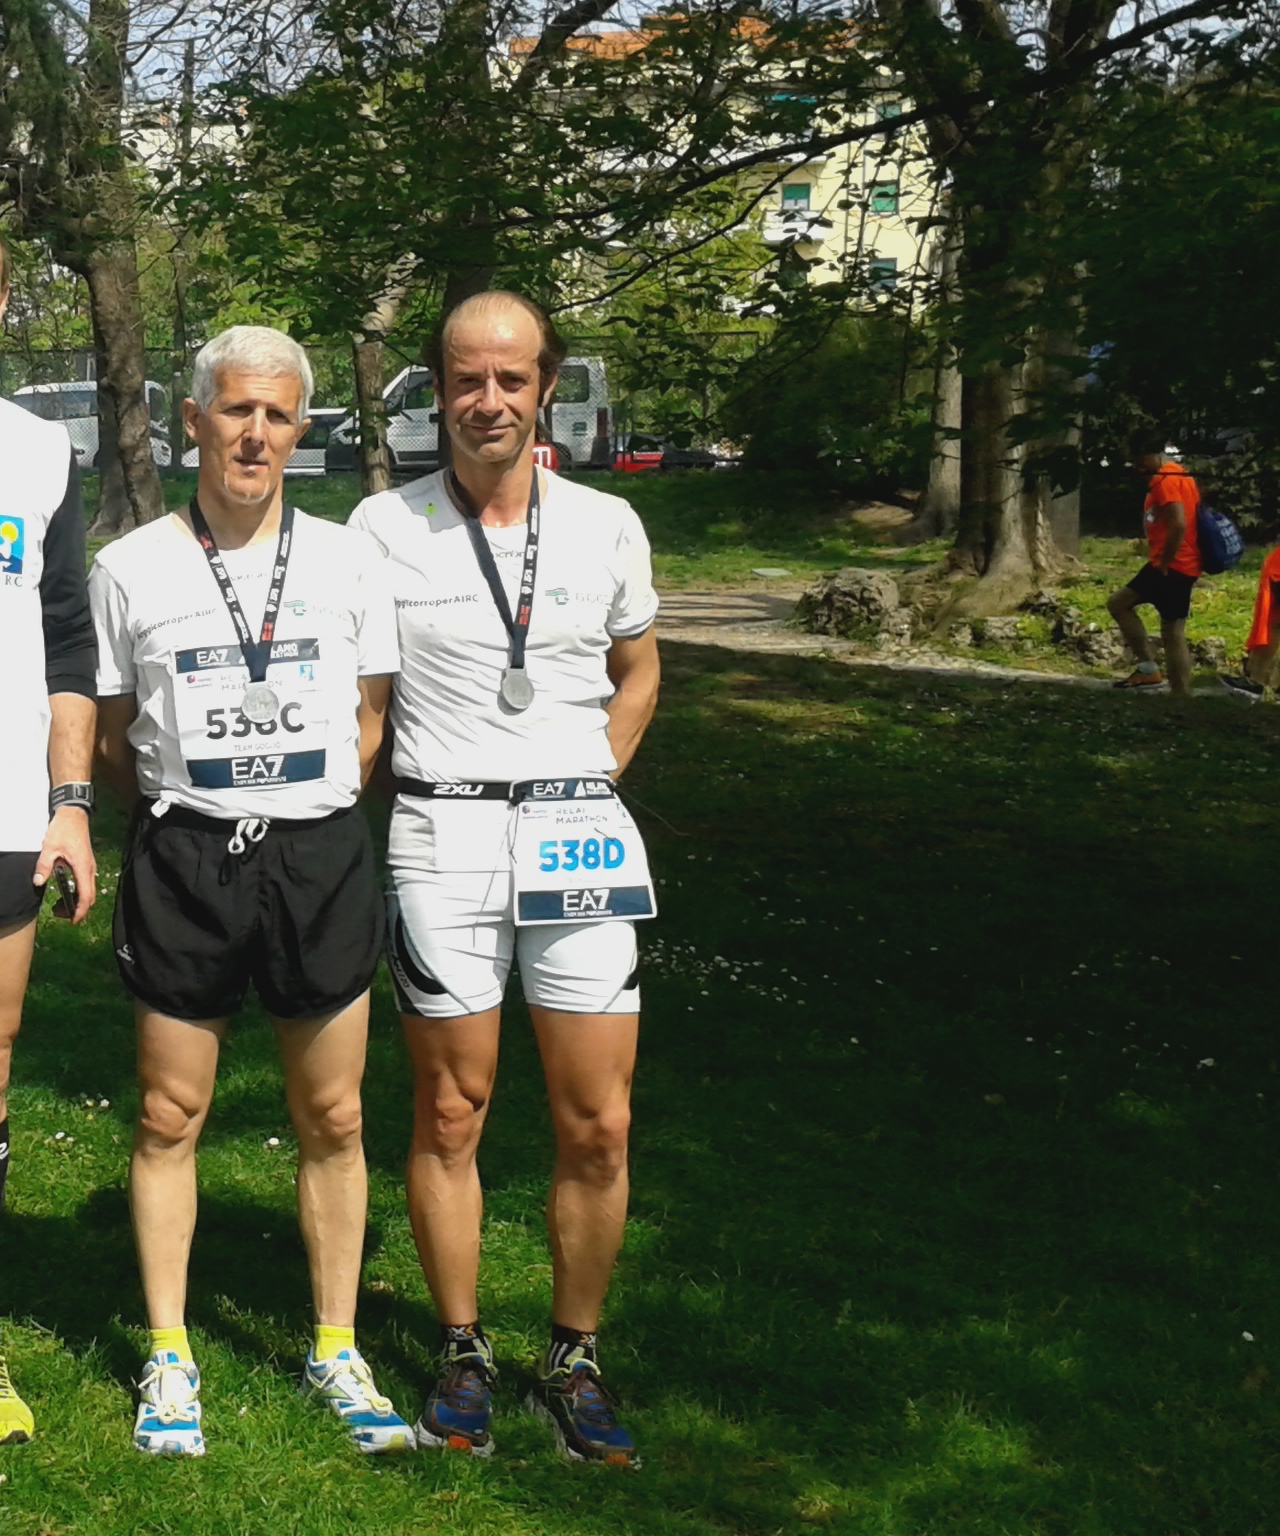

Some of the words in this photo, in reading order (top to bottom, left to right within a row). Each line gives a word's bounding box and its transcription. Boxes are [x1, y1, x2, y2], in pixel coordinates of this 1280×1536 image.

[196, 649, 229, 664] EA7
[232, 755, 284, 779] EA7
[433, 784, 484, 795] 2XU
[533, 781, 565, 795] EA7
[555, 815, 608, 824] MARATHON
[539, 837, 626, 872] 538D
[563, 889, 610, 911] EA7
